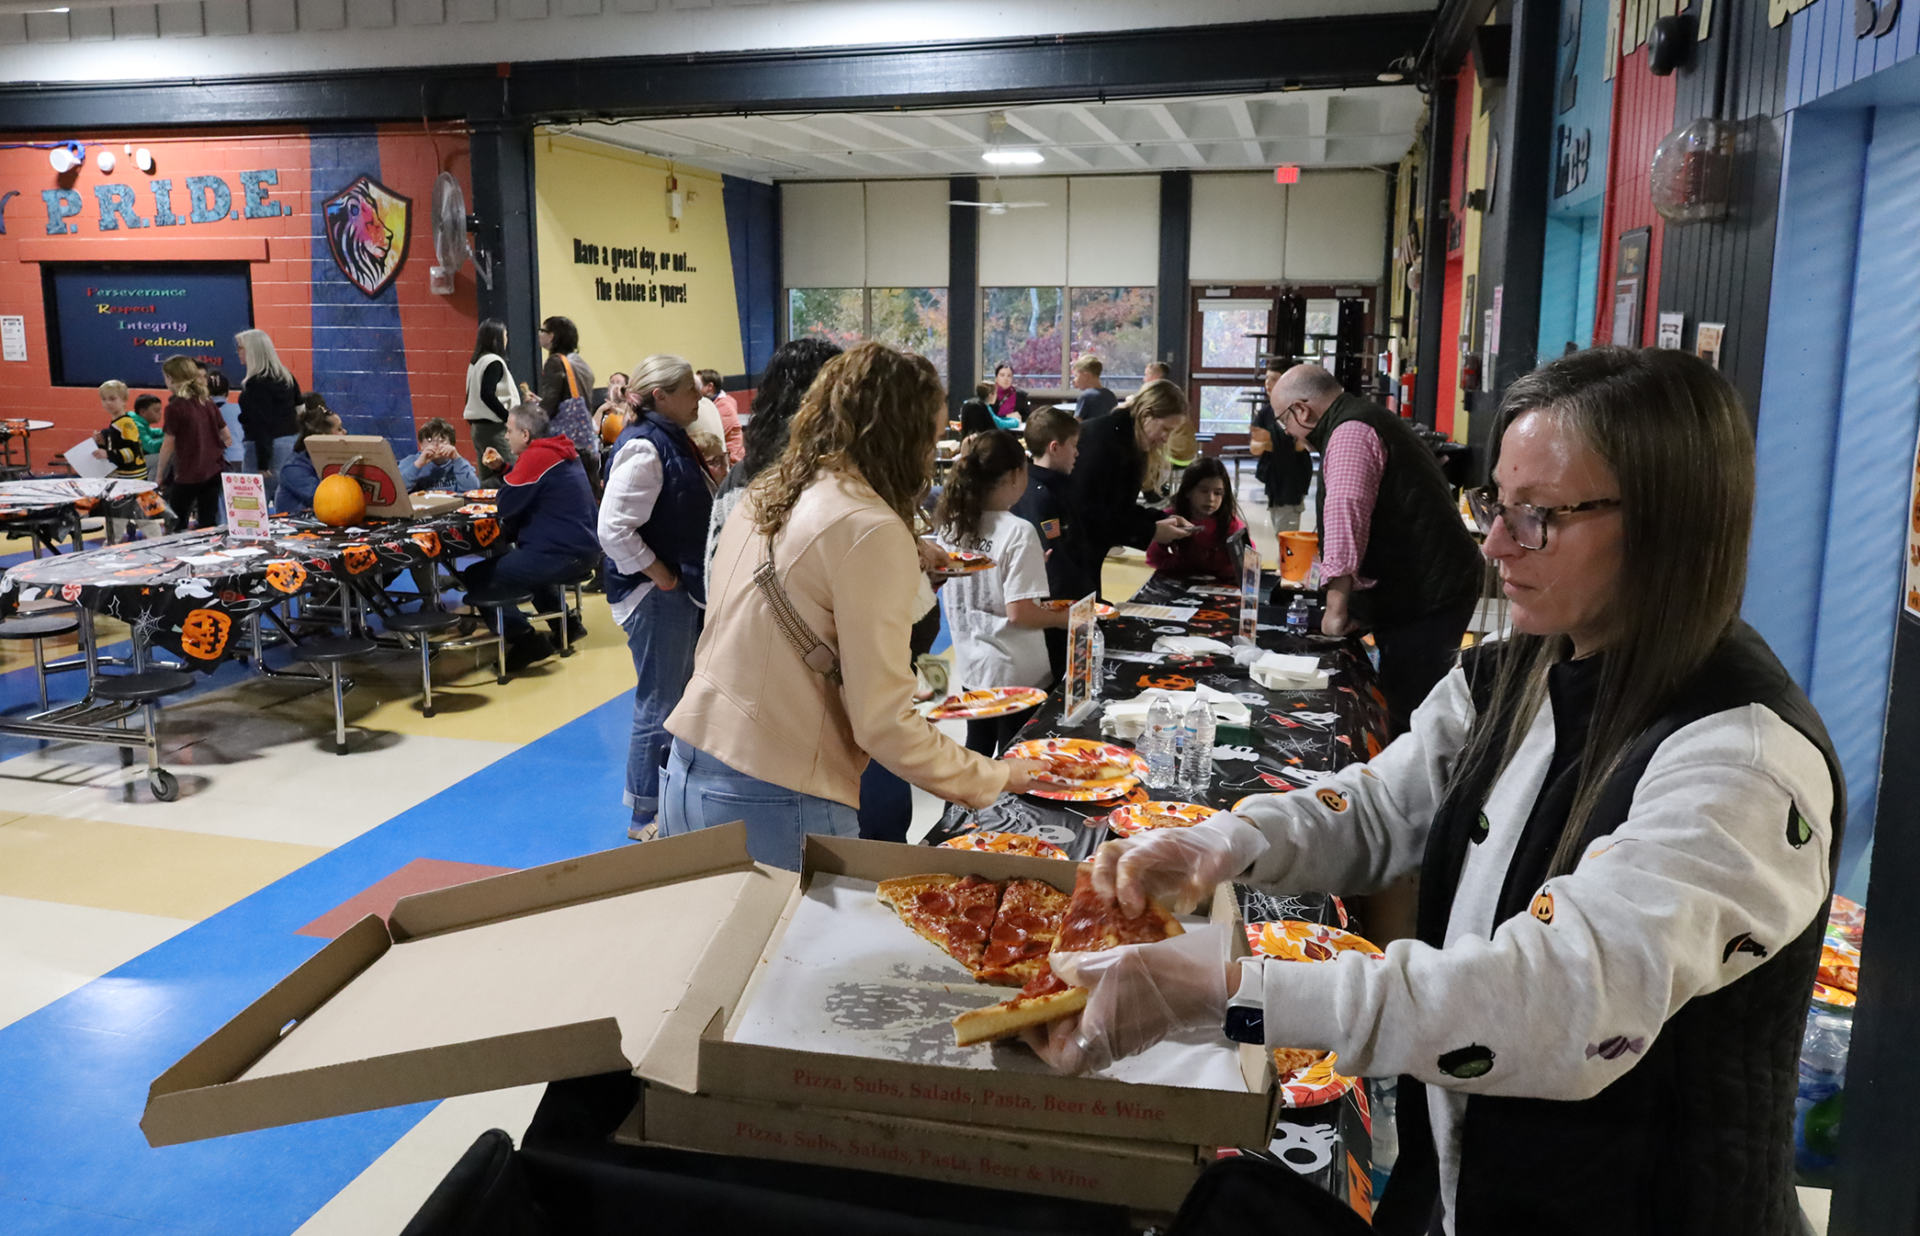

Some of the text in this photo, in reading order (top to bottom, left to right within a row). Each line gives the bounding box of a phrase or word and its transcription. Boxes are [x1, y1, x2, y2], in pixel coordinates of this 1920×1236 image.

[573, 238, 697, 275] Have a great day, or not...
[86, 287, 187, 297] Perseverance
[595, 276, 687, 308] the choice is yours!
[96, 304, 156, 314] Respect
[118, 320, 188, 333] Integrity
[134, 337, 215, 347] Dedication
[154, 354, 223, 366] Ethy
[793, 1069, 1165, 1121] Pizza, Subs, Salads, Pasta, Beer & Wine
[736, 1121, 1099, 1189] Pizza, Subs, Salads, Pasta, Beer & Wine
